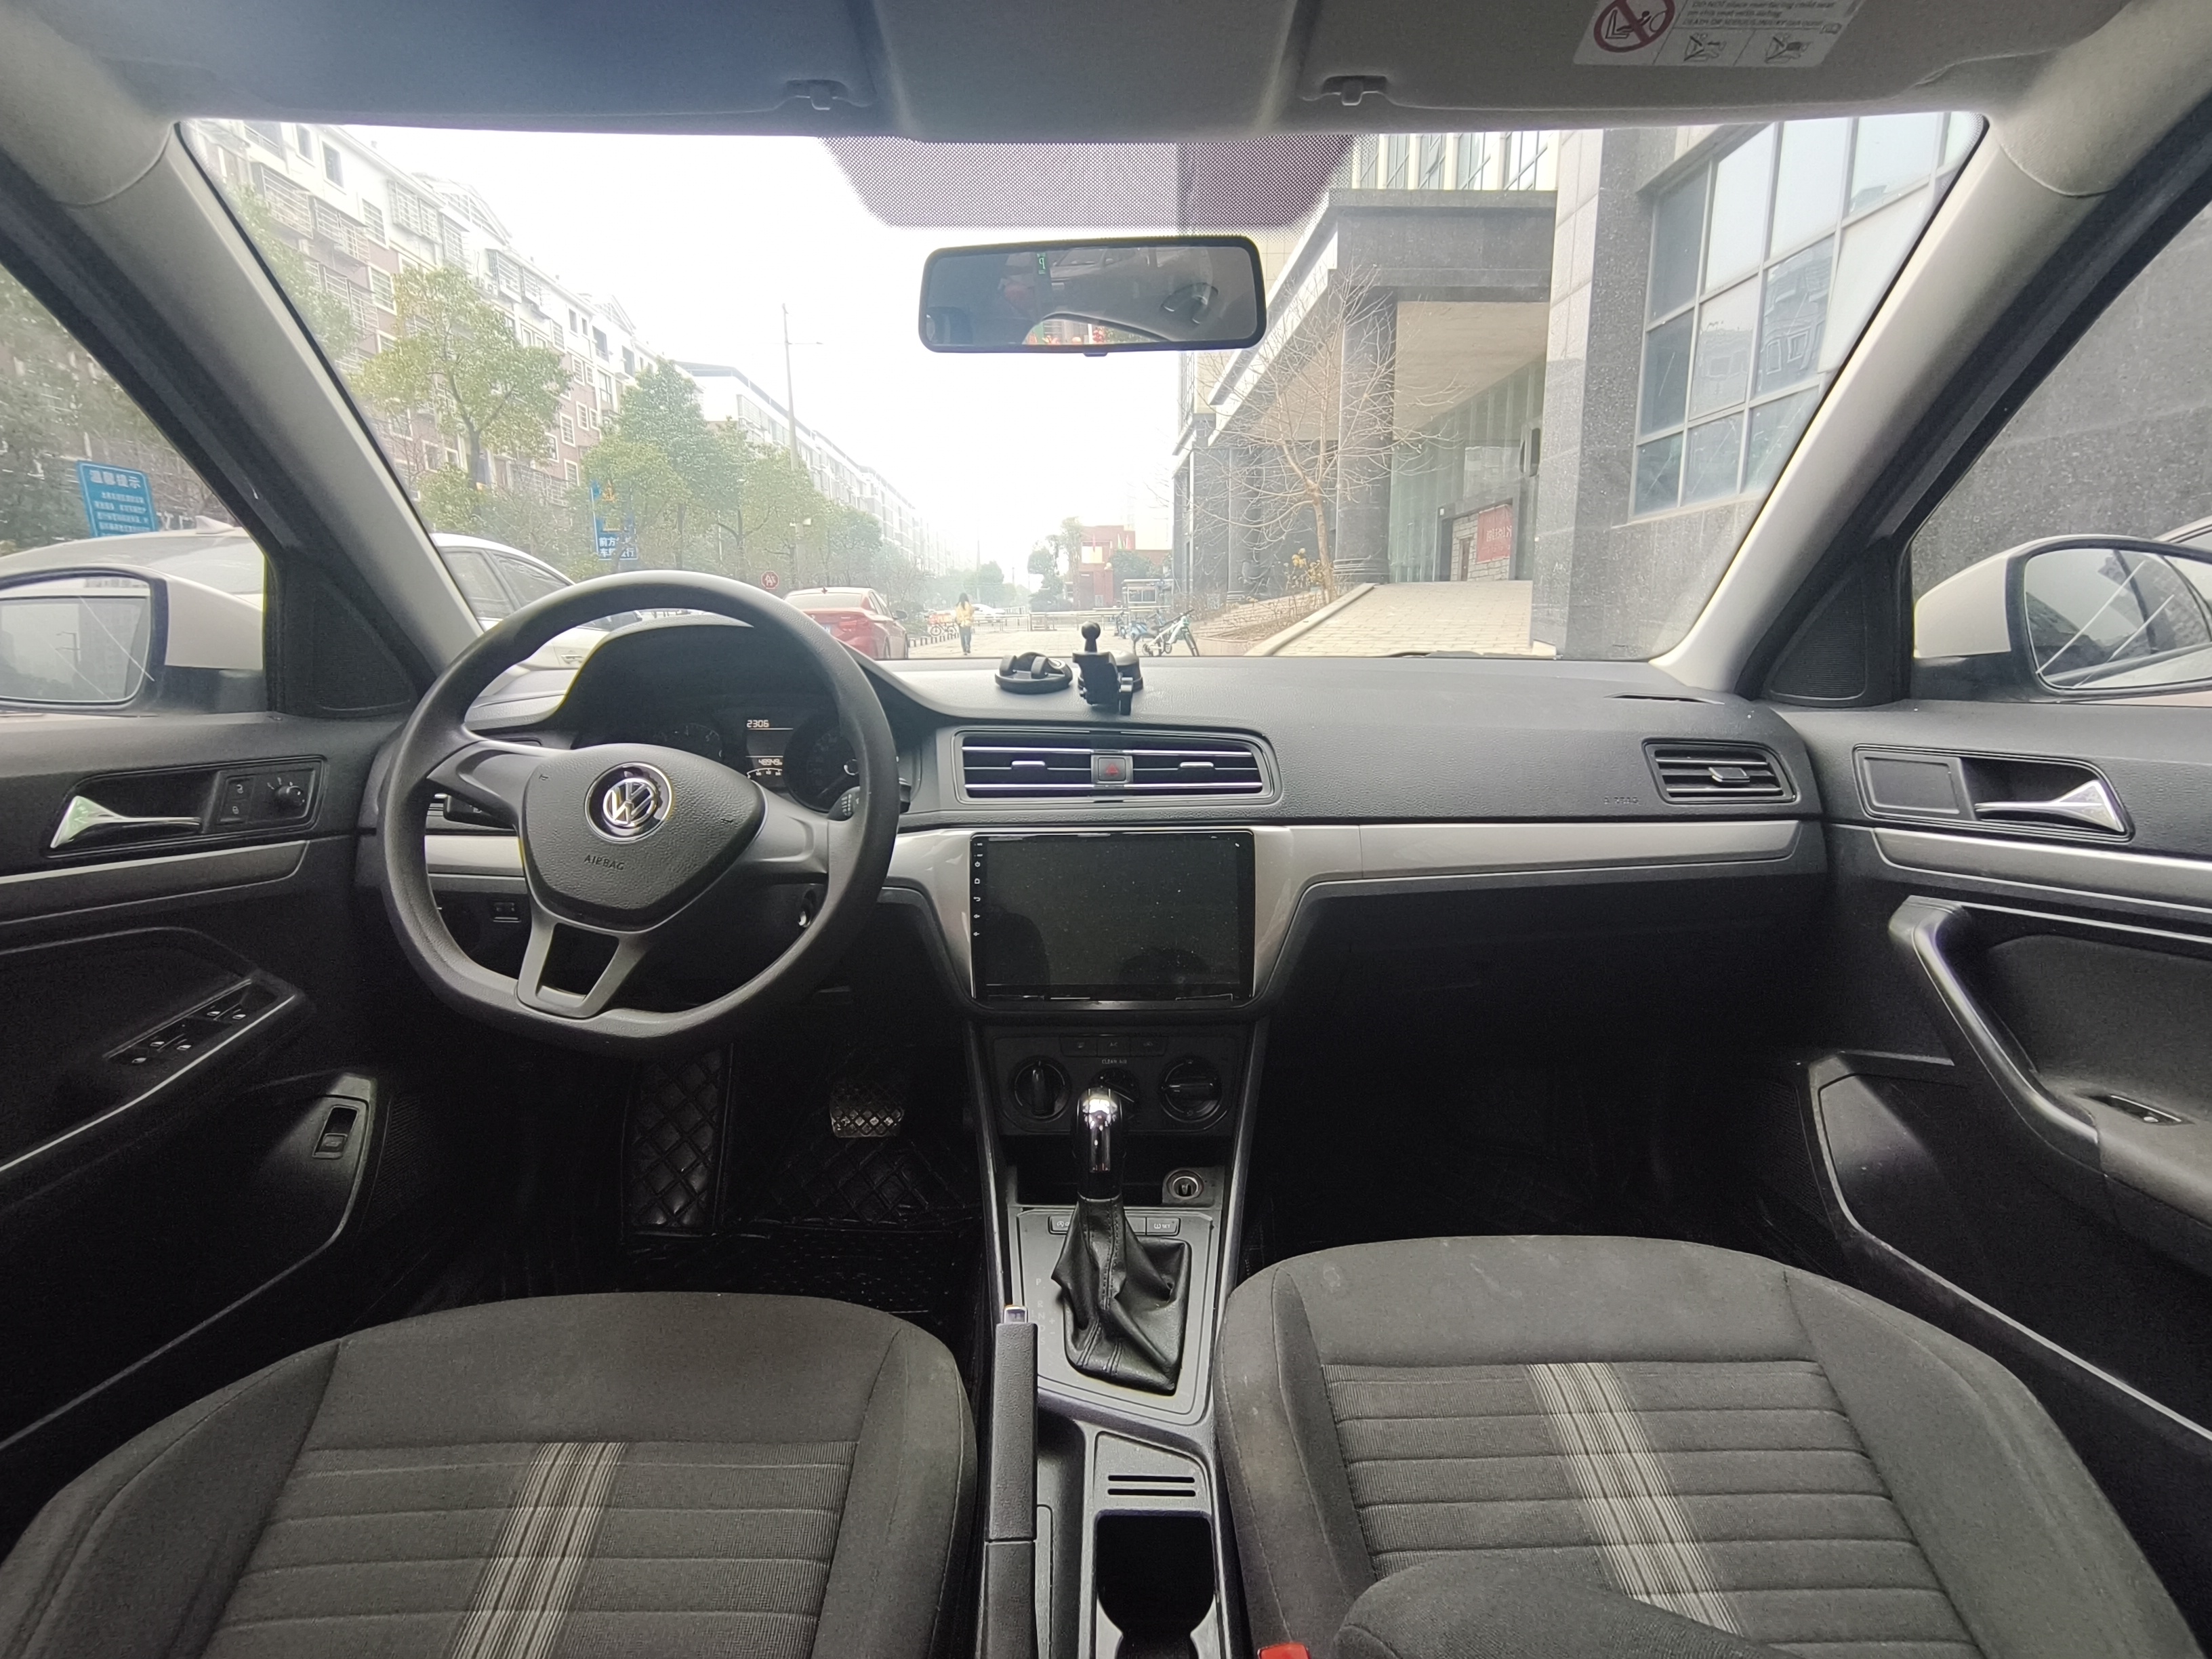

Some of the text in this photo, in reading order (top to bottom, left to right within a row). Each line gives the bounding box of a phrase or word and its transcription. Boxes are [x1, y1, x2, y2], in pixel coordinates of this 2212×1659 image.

[584, 855, 625, 870] AIRBAG
[1036, 1277, 1042, 1286] P
[1037, 1300, 1044, 1308] R
[1038, 1312, 1046, 1320] N
[1040, 1337, 1046, 1345] S
